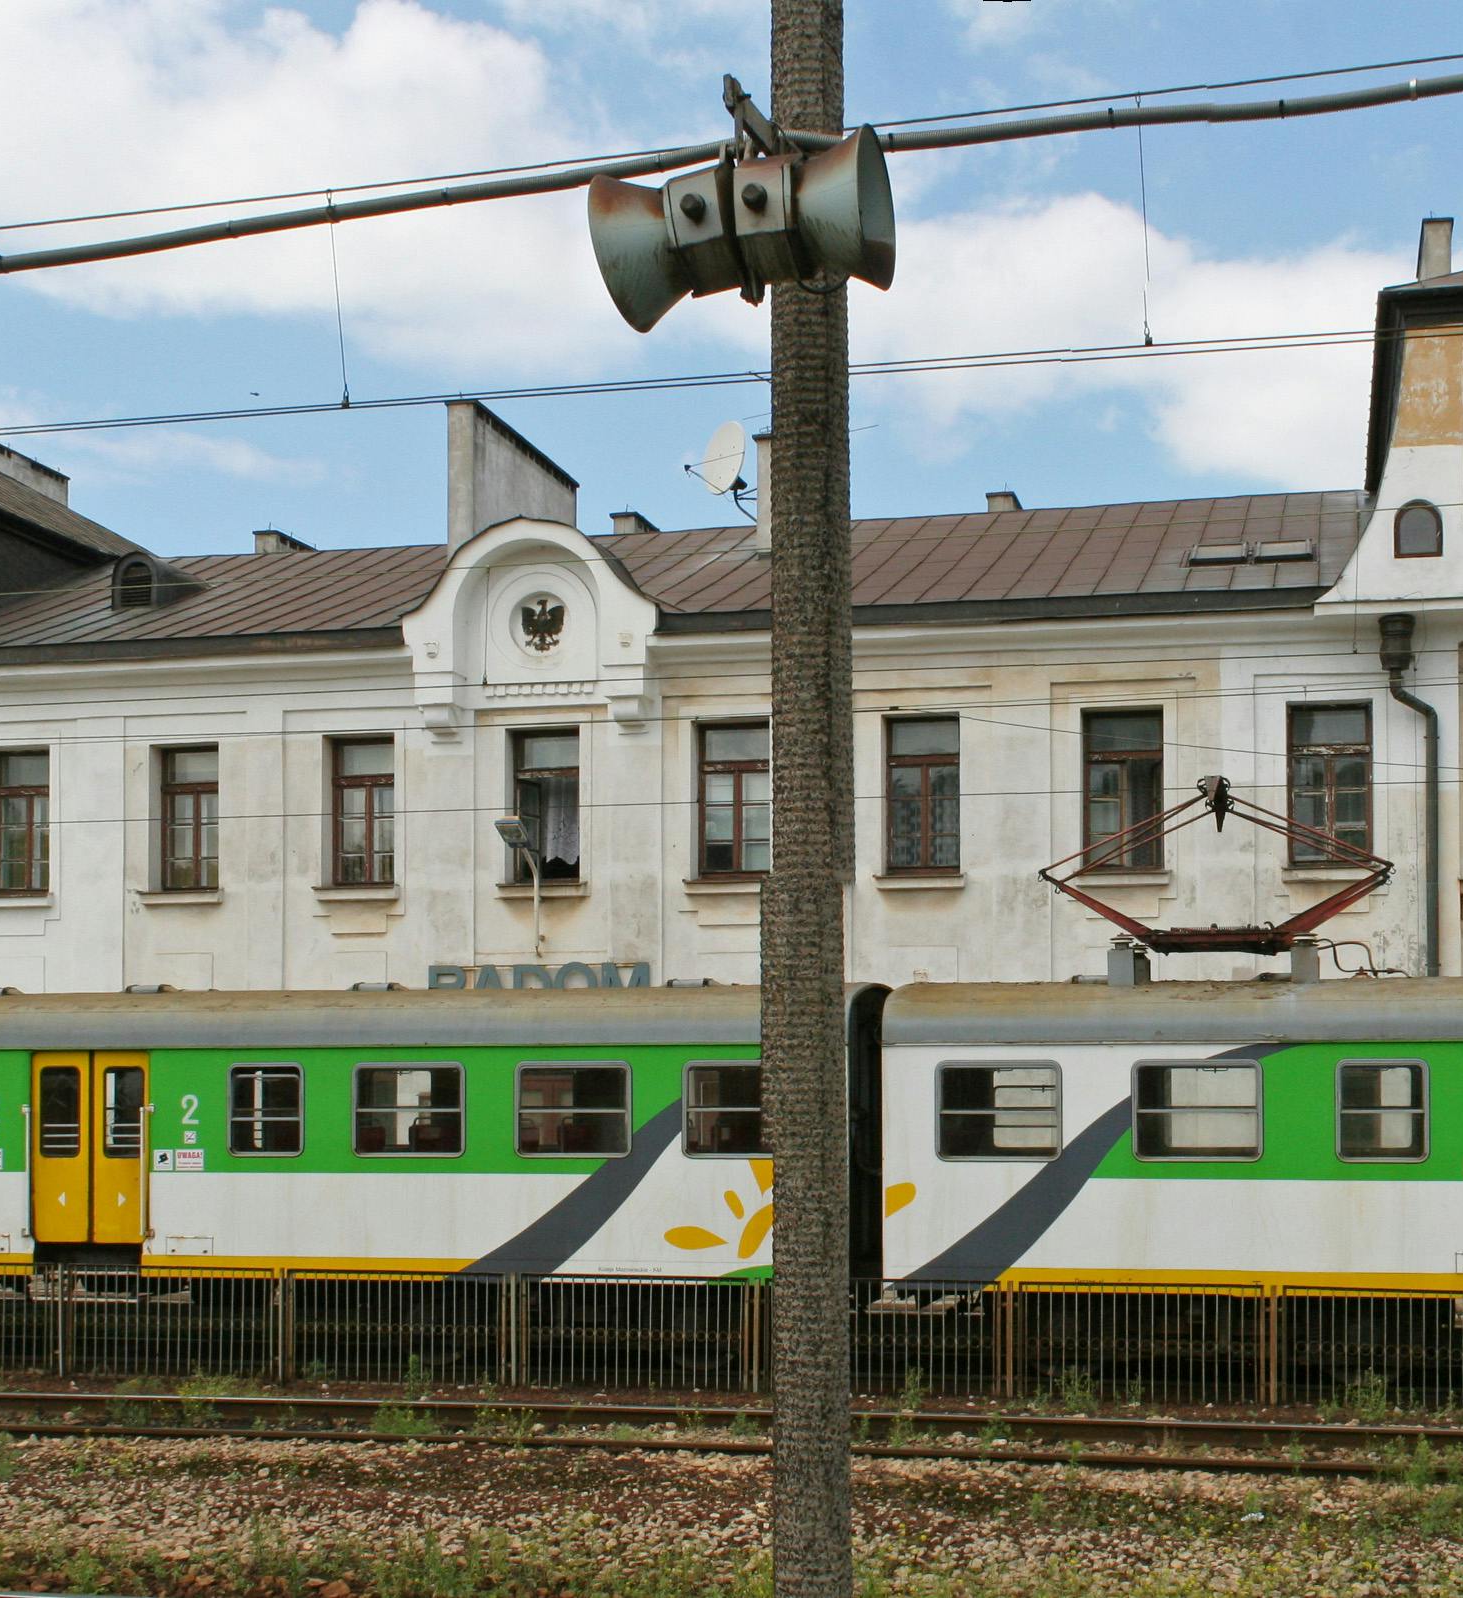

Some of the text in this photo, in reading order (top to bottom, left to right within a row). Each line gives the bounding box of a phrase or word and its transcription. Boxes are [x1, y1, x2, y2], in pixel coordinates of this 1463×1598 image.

[428, 961, 650, 989] RADOM
[181, 1094, 199, 1124] 2
[177, 1151, 203, 1159] UWAGA!
